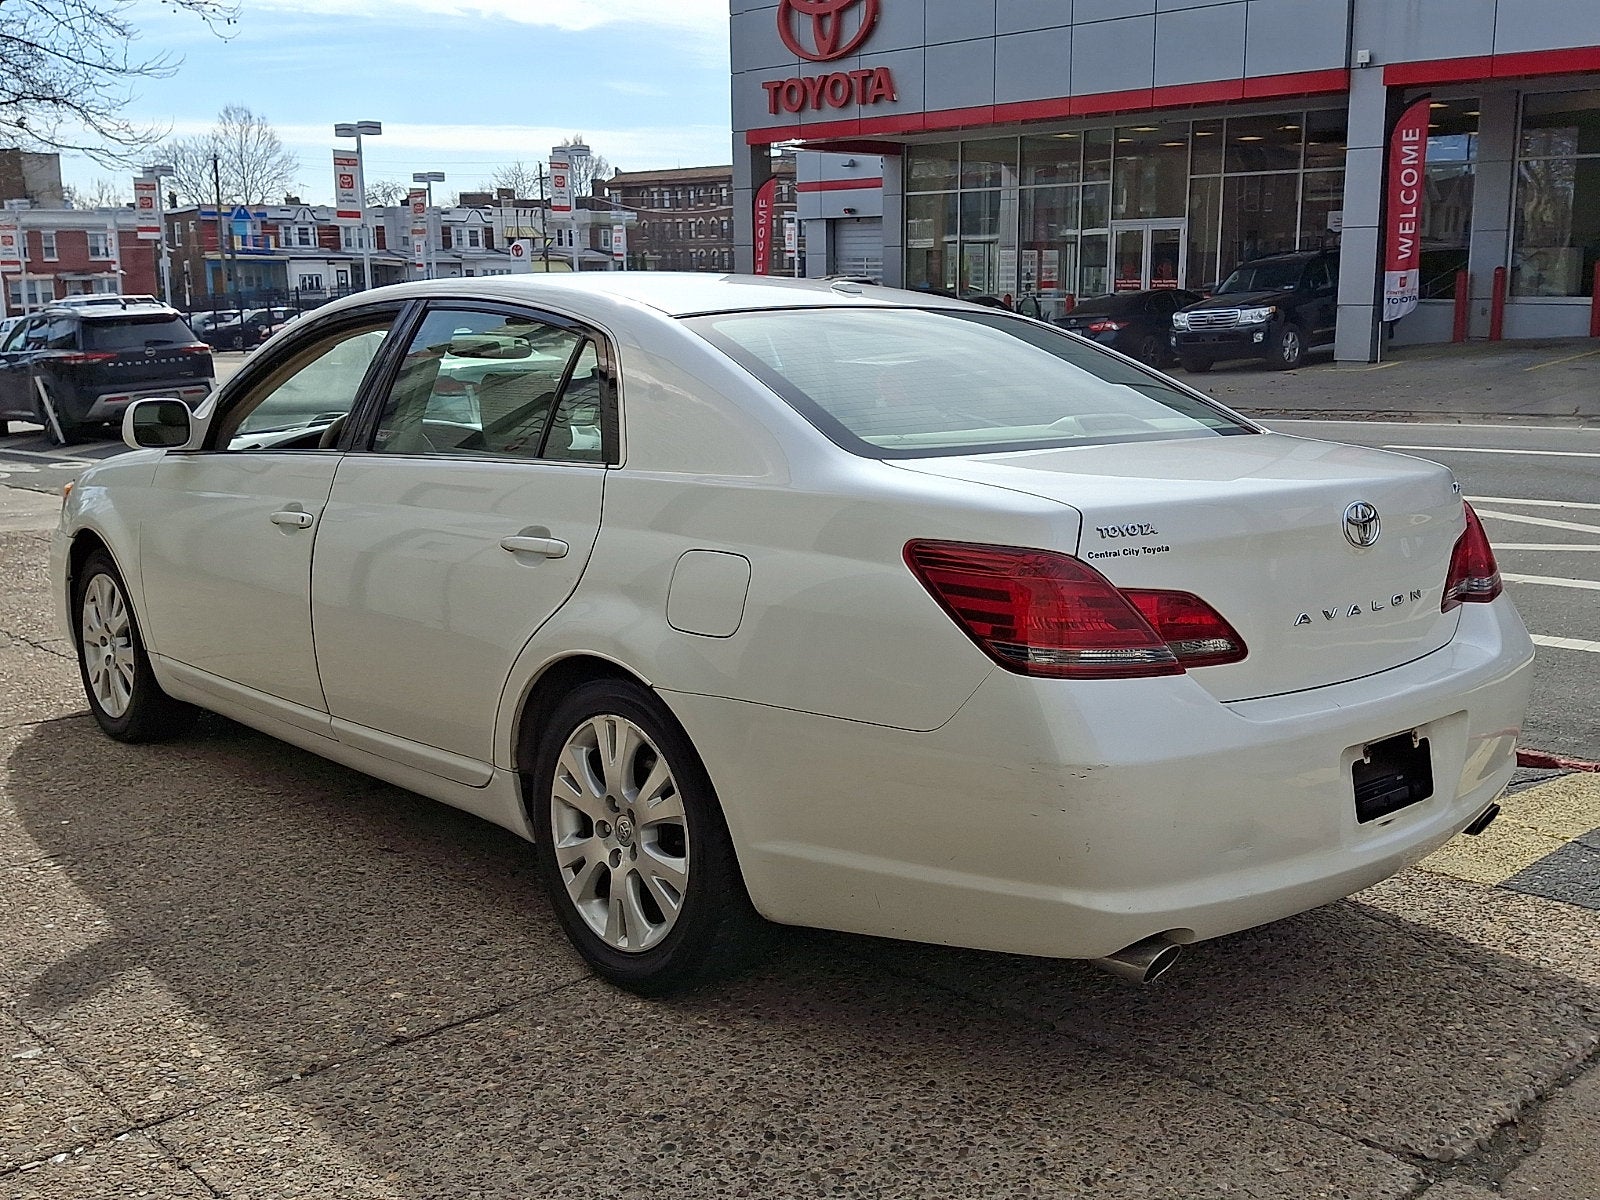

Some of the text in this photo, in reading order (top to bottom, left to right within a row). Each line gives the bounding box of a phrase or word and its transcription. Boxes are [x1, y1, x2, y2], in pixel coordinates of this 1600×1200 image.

[762, 67, 897, 115] TOYOTA
[1398, 128, 1420, 260] WELCOME
[756, 199, 768, 273] ELCOME
[108, 356, 191, 367] PATHFINDER
[1096, 523, 1159, 539] TOYOTA
[1087, 545, 1170, 559] Central City Toyota
[1294, 589, 1422, 626] AVALON
